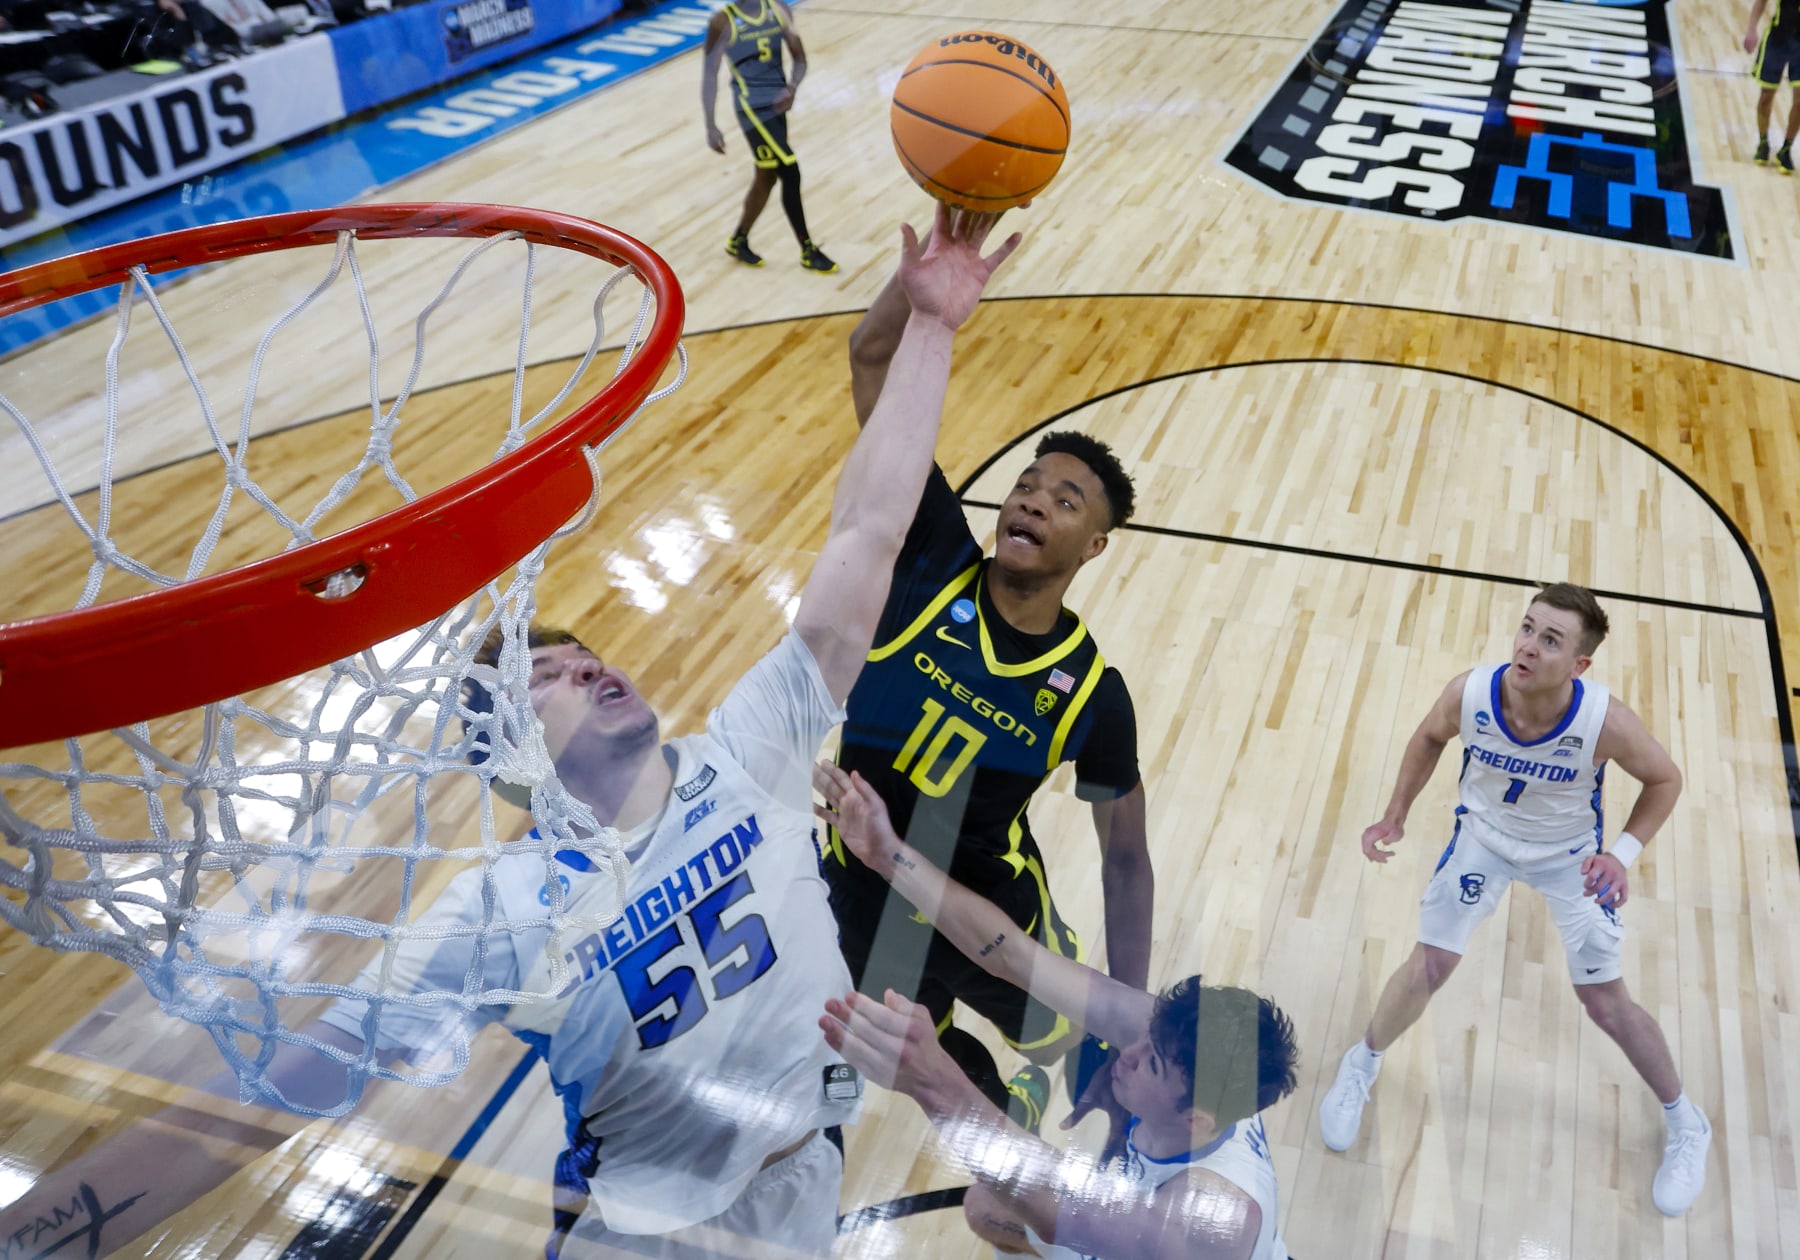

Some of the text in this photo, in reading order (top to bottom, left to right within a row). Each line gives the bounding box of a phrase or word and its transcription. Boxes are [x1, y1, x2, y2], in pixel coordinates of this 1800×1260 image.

[757, 37, 772, 62] 5
[939, 33, 1056, 90] Wilson
[1506, 0, 1656, 137] MARCH
[386, 56, 618, 138] FOUR
[1293, 8, 1513, 211] MADNESS
[914, 652, 1037, 747] OREGON
[892, 697, 988, 798] 10
[1469, 744, 1579, 783] CREIGHTON
[1503, 777, 1528, 804] 1
[611, 870, 778, 1051] 55
[830, 1068, 849, 1079] 46
